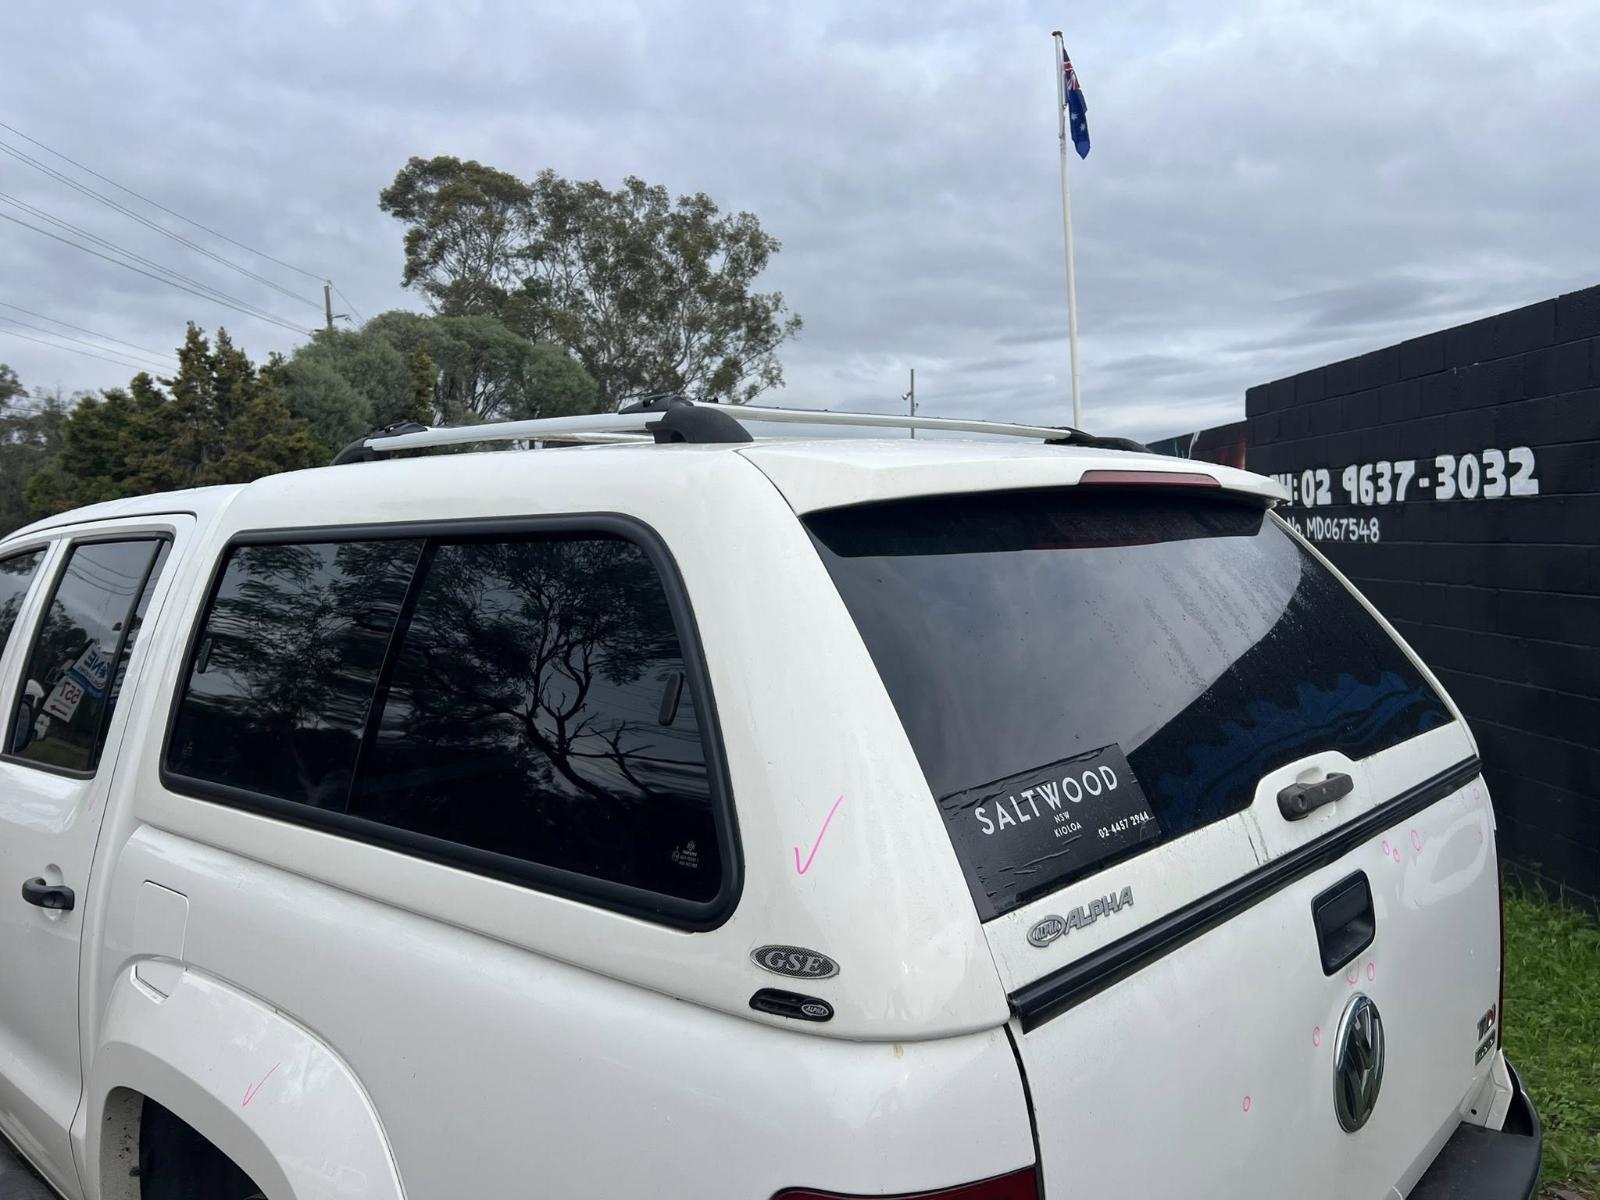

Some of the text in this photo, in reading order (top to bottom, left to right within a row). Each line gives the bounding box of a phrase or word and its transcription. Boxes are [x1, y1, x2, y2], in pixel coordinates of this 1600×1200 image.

[1342, 447, 1539, 506] 9637-3032
[1306, 516, 1380, 543] MD067548
[974, 765, 1118, 835] SALTWOOD
[1053, 811, 1070, 824] NSW
[1053, 822, 1082, 838] KIOLOA
[1098, 827, 1110, 838] 02
[1111, 818, 1129, 833] 4457
[1063, 885, 1135, 936] ALPHA
[765, 950, 823, 974] GSE
